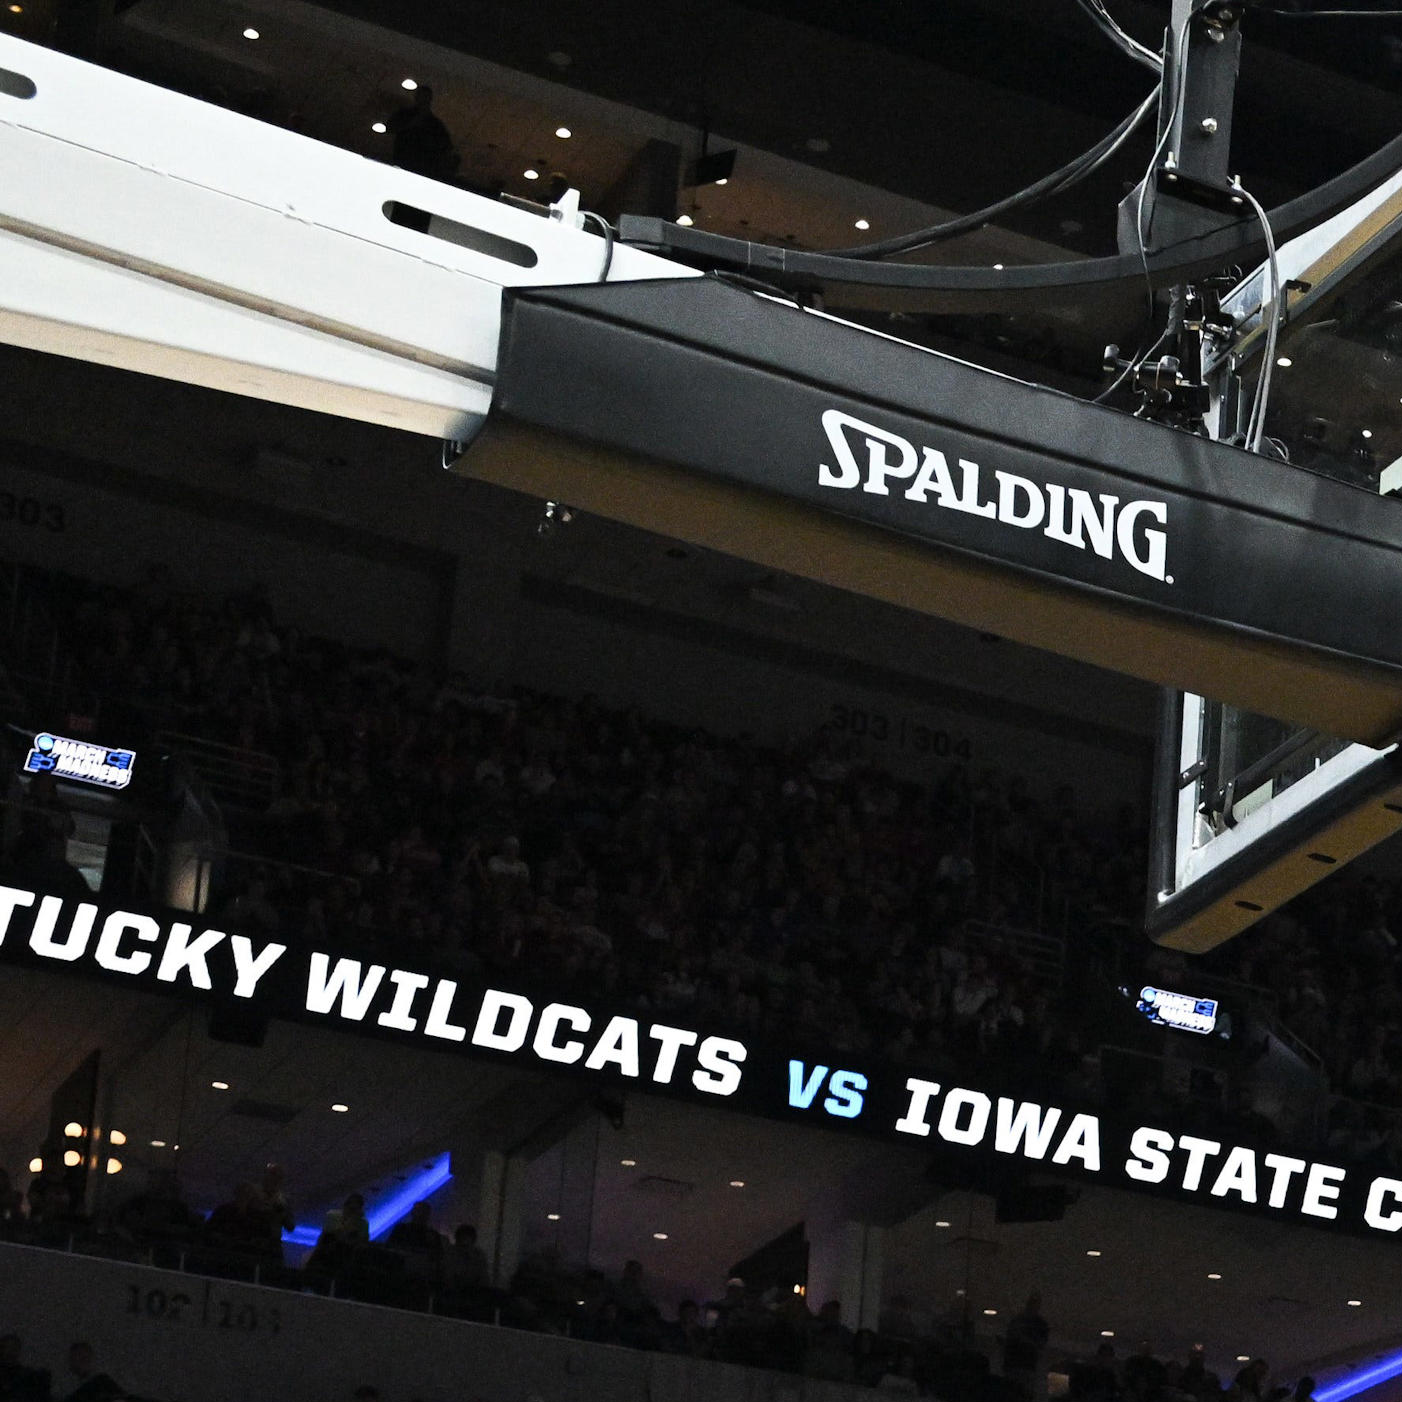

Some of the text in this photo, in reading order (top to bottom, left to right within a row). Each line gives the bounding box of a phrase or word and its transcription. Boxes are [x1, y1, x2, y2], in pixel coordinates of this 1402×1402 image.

[819, 410, 1168, 581] SPALDING
[305, 952, 748, 1096] WILDCATS
[788, 1059, 869, 1119] VS
[895, 1077, 1101, 1172] IOWA
[1125, 1126, 1346, 1220] STATE
